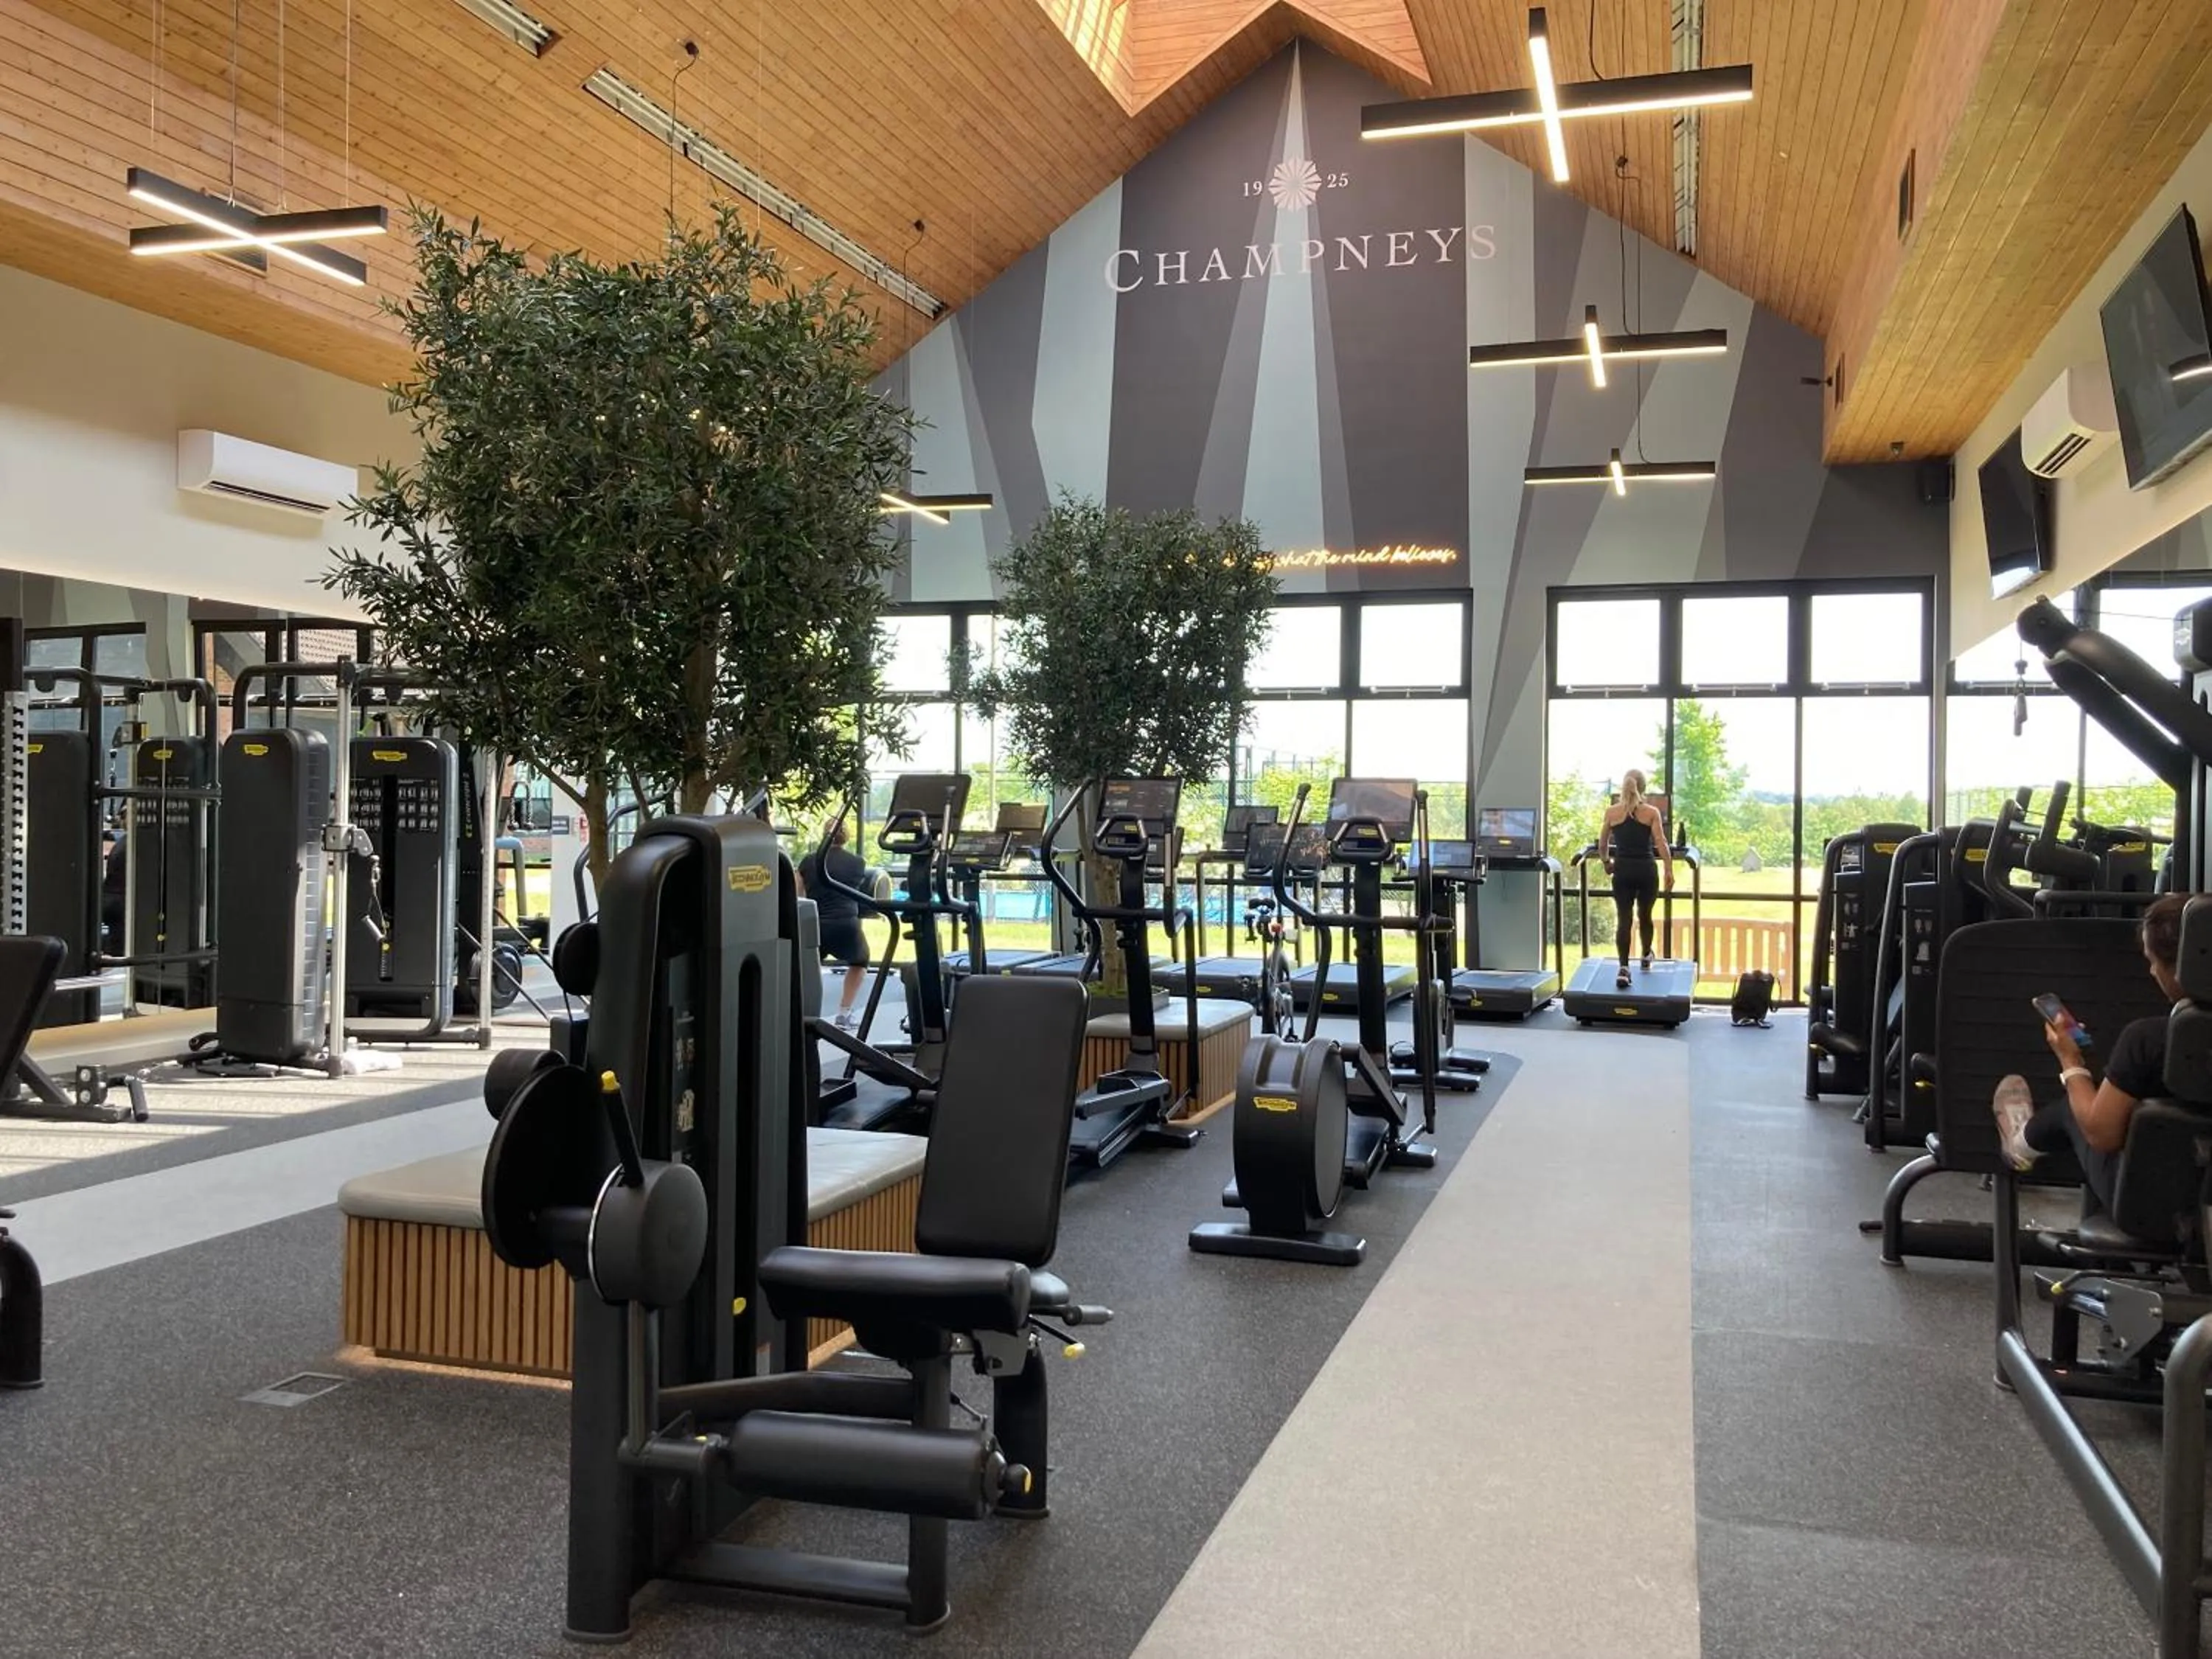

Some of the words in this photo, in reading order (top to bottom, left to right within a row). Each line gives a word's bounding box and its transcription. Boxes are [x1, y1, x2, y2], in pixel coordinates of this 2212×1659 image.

[1242, 181, 1263, 197] 19
[1327, 173, 1349, 188] 25
[1105, 225, 1497, 293] CHAMPNEYS
